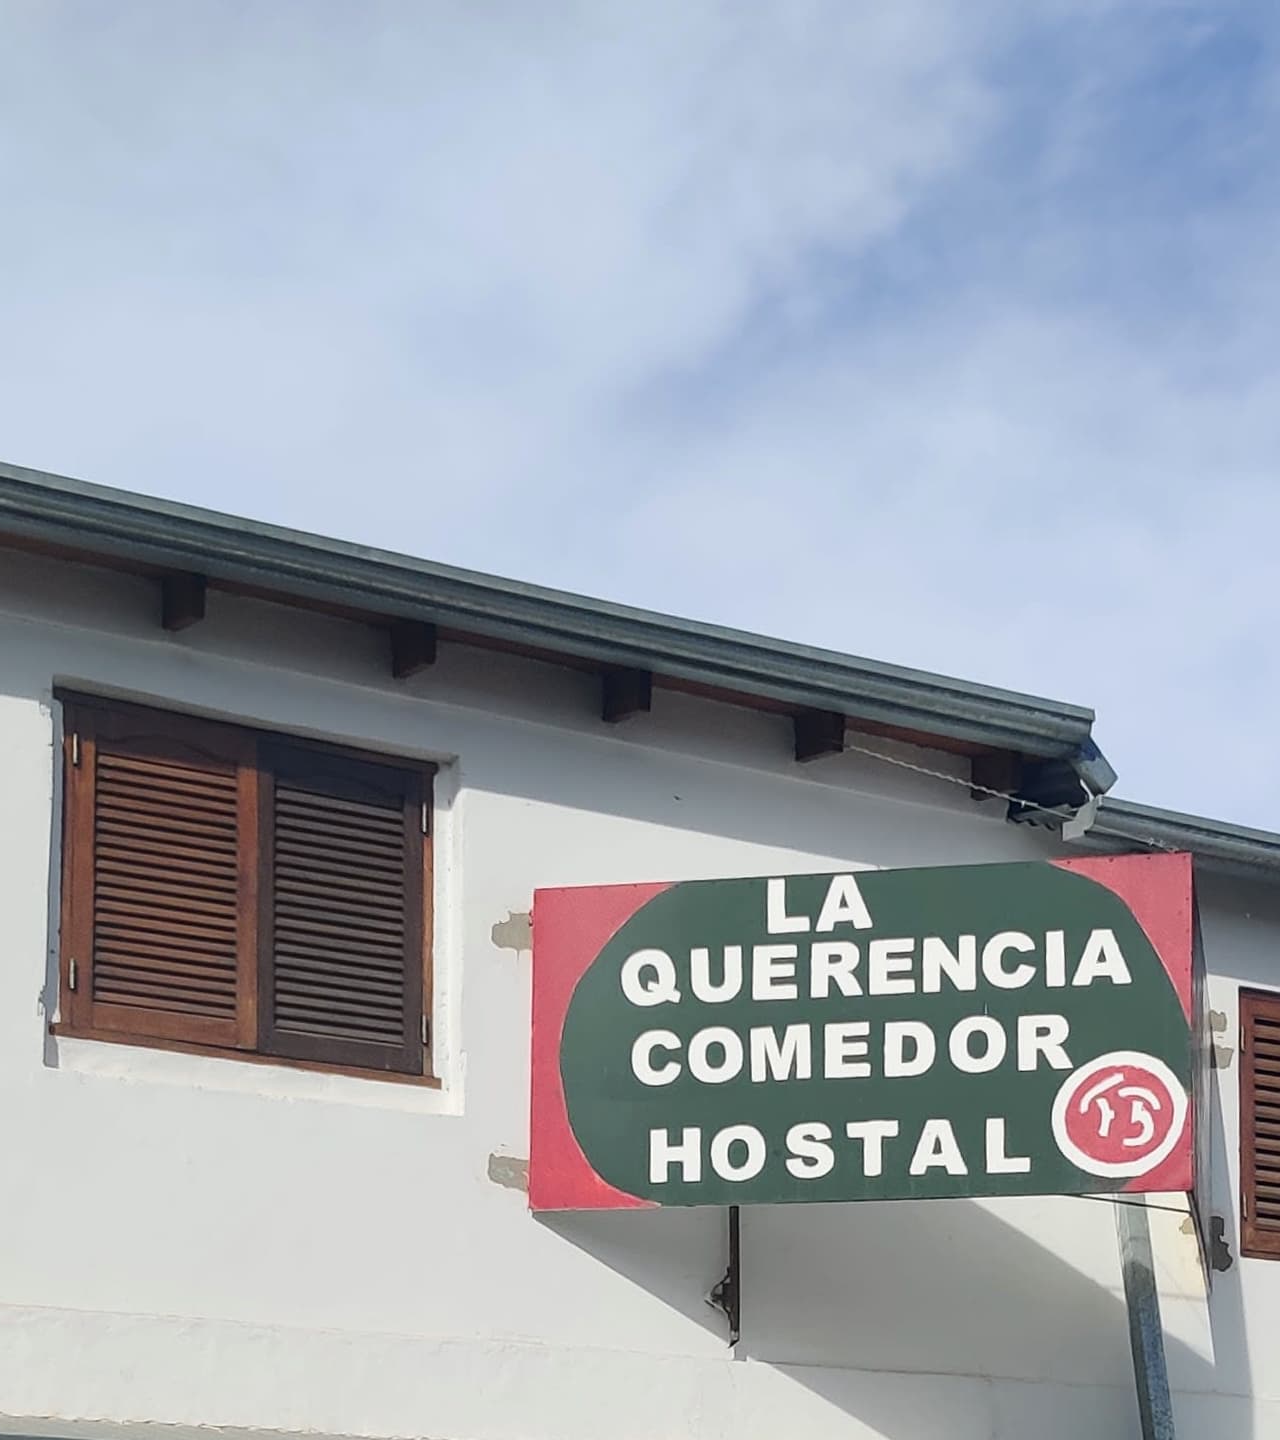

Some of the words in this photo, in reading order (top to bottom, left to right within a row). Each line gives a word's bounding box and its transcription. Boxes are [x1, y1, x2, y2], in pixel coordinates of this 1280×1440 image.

[767, 875, 873, 934] LA
[620, 929, 1132, 1005] QUERENCIA
[631, 1014, 1074, 1086] COMEDOR
[649, 1118, 1032, 1183] HOSTAL
